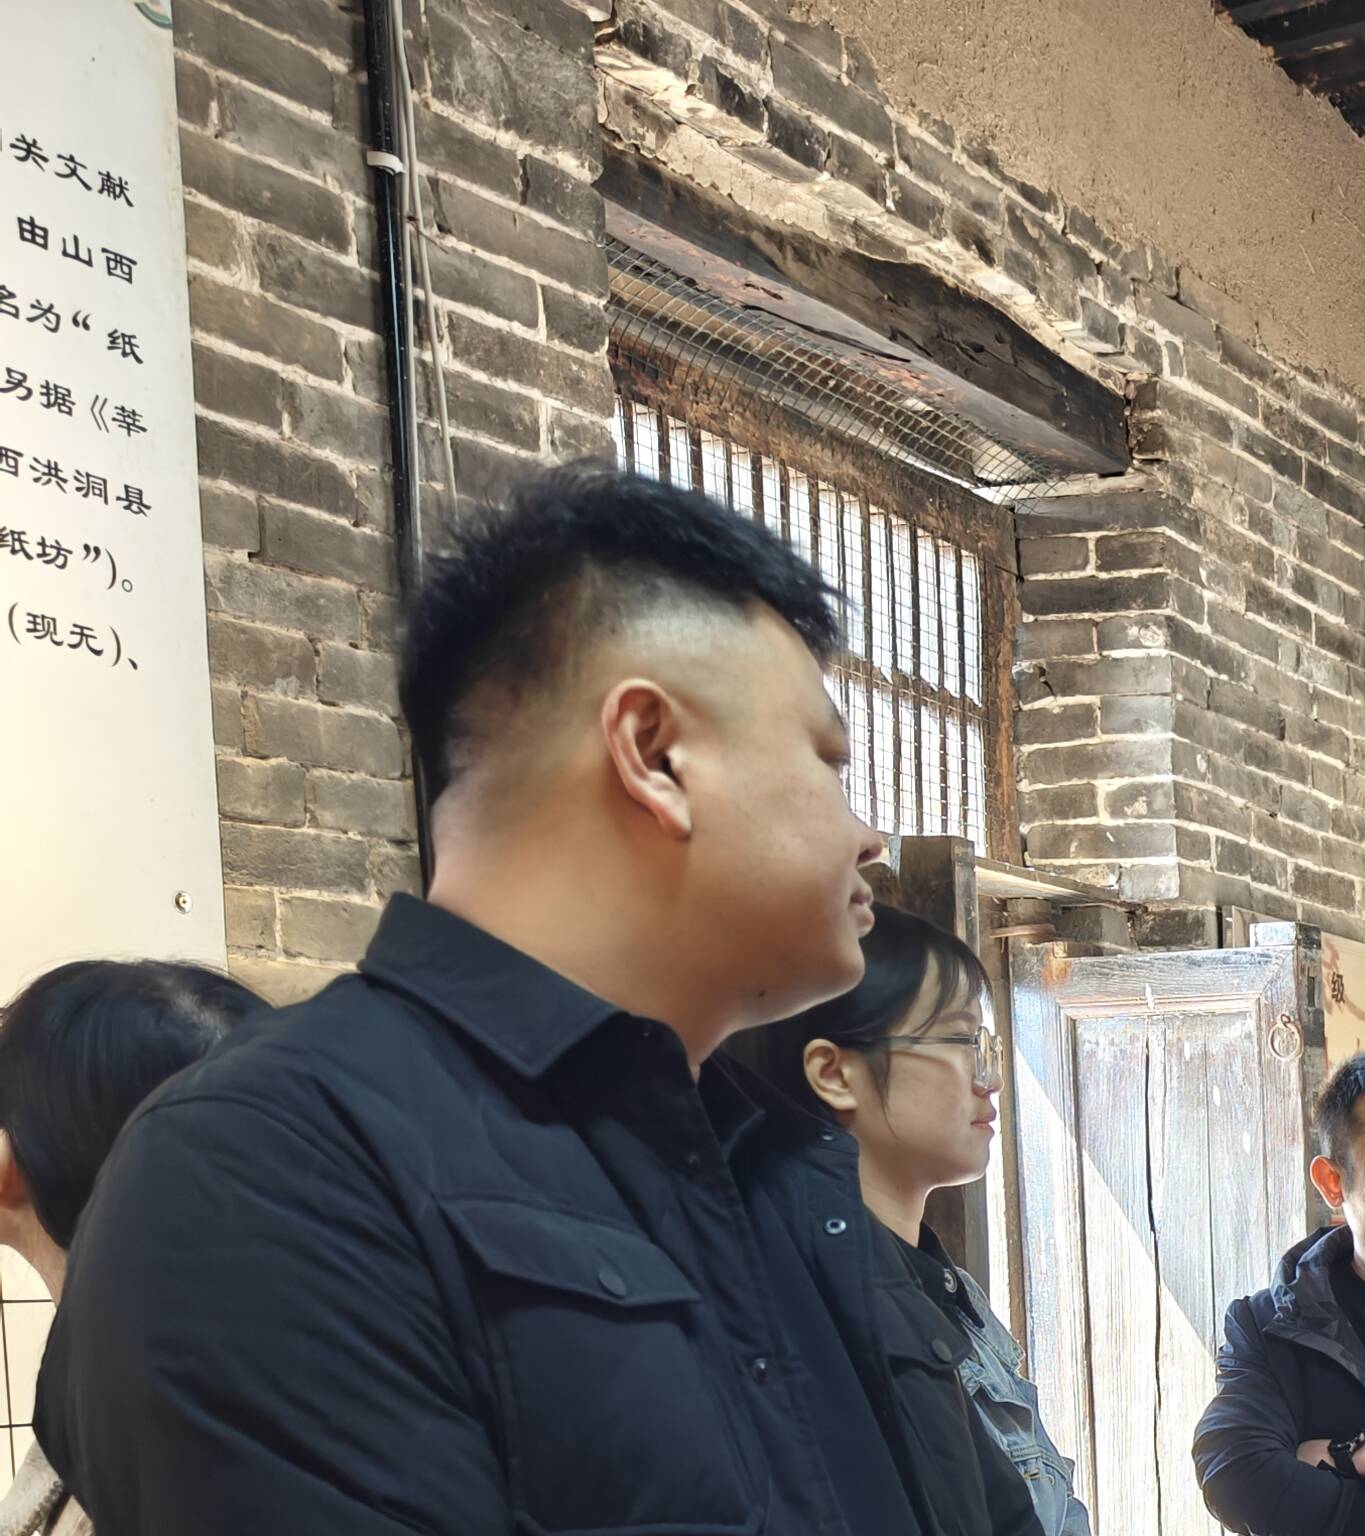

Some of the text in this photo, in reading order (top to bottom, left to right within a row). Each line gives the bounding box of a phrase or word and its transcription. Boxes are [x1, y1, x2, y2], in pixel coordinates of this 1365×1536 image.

[9, 134, 134, 207] 关文献
[17, 215, 138, 284] 由山西
[0, 446, 152, 517] 西洪洞县
